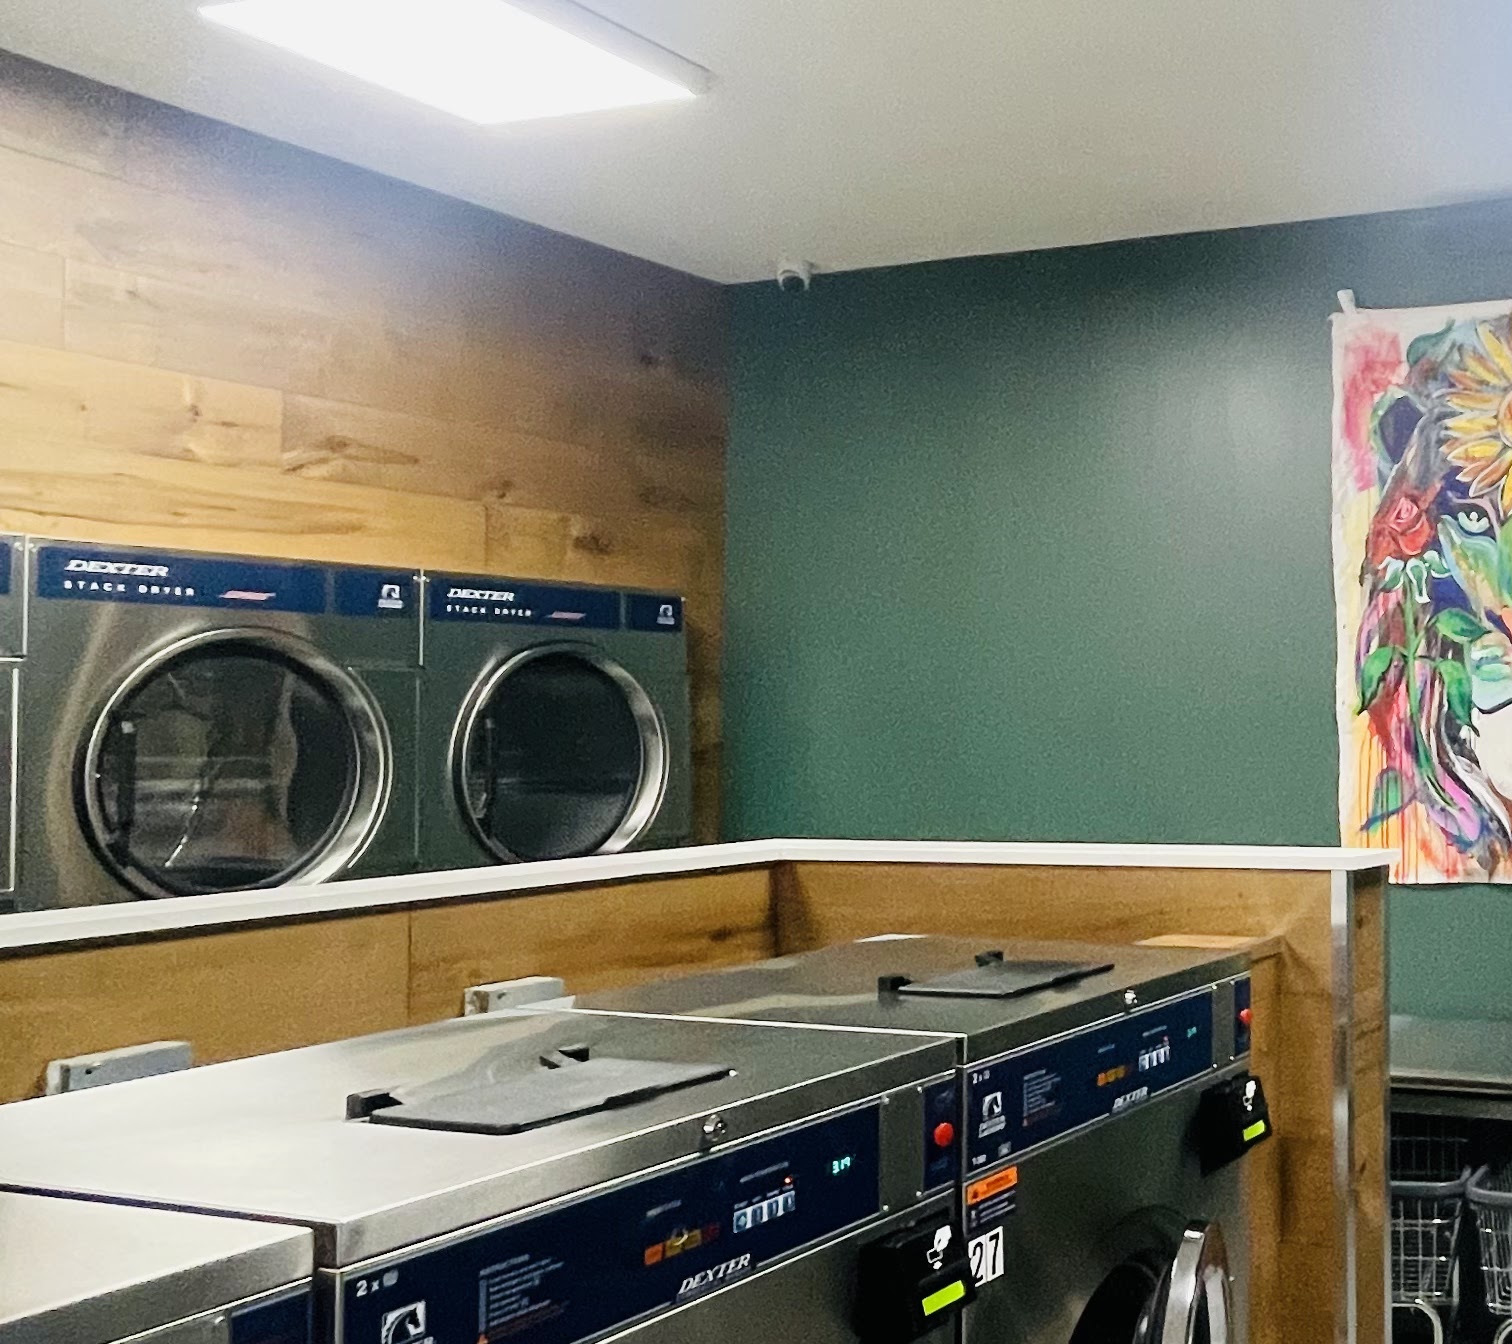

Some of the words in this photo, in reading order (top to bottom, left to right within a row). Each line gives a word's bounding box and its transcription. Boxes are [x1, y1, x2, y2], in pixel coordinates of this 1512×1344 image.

[65, 559, 170, 577] DEXTER
[64, 580, 127, 593] STACK
[138, 584, 195, 597] DRYER
[447, 588, 515, 602] DEXTER
[972, 1231, 1000, 1284] 27
[679, 1253, 751, 1295] DEXTER
[356, 1279, 368, 1298] 2
